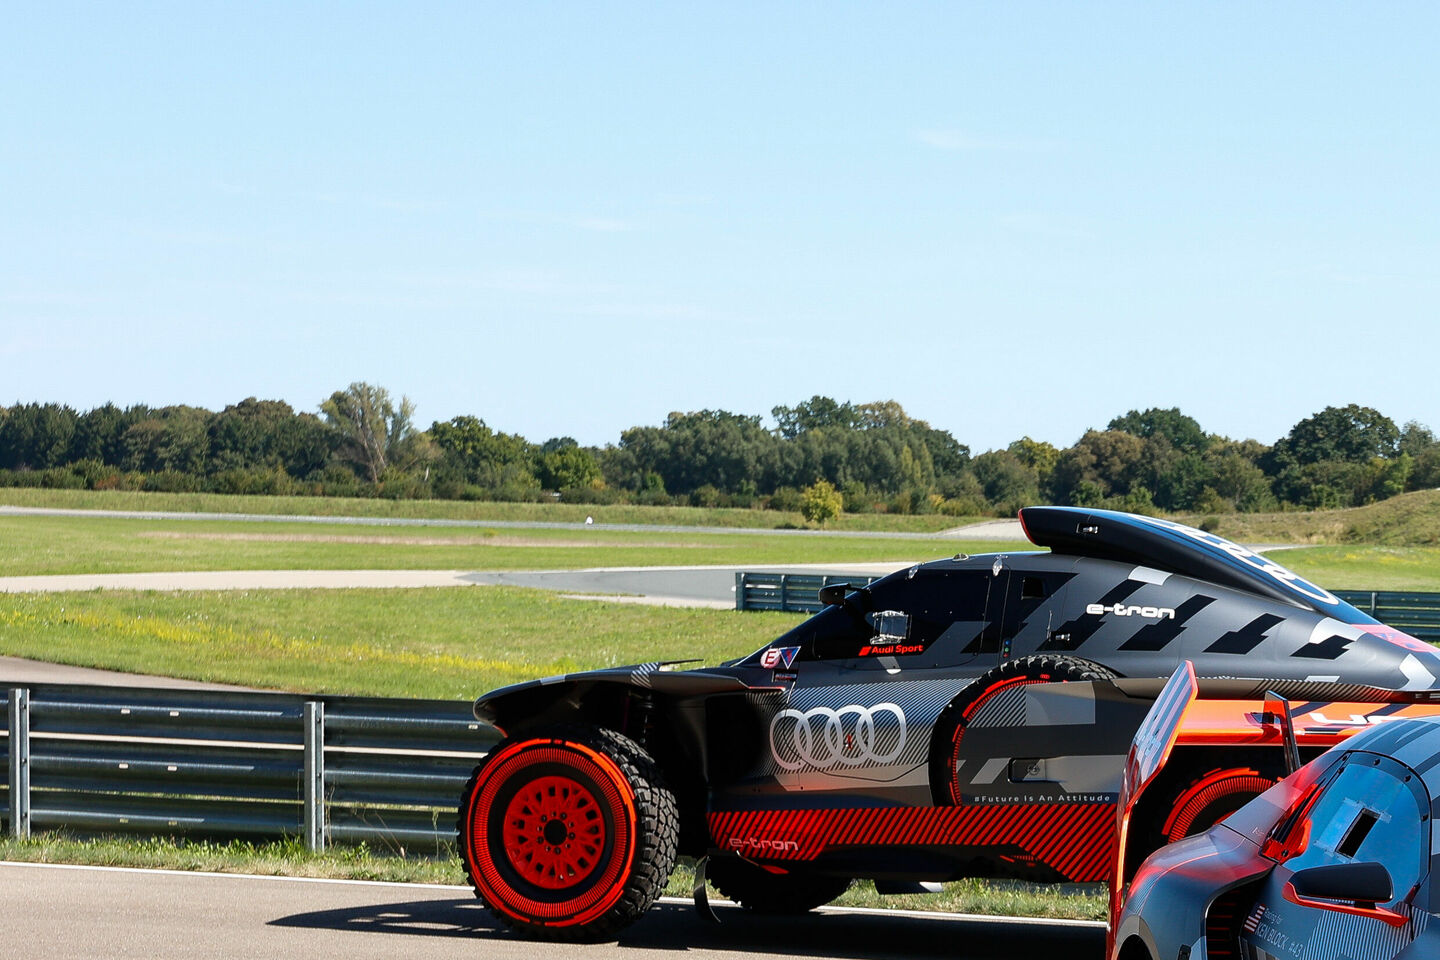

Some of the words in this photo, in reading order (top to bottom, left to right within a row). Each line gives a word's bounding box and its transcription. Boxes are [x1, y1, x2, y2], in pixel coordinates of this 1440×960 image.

[1086, 603, 1175, 619] e-tron
[871, 646, 894, 654] Audi
[895, 644, 924, 654] Sport
[765, 651, 777, 664] E
[1058, 794, 1110, 802] Attitude
[729, 837, 799, 851] e-tron
